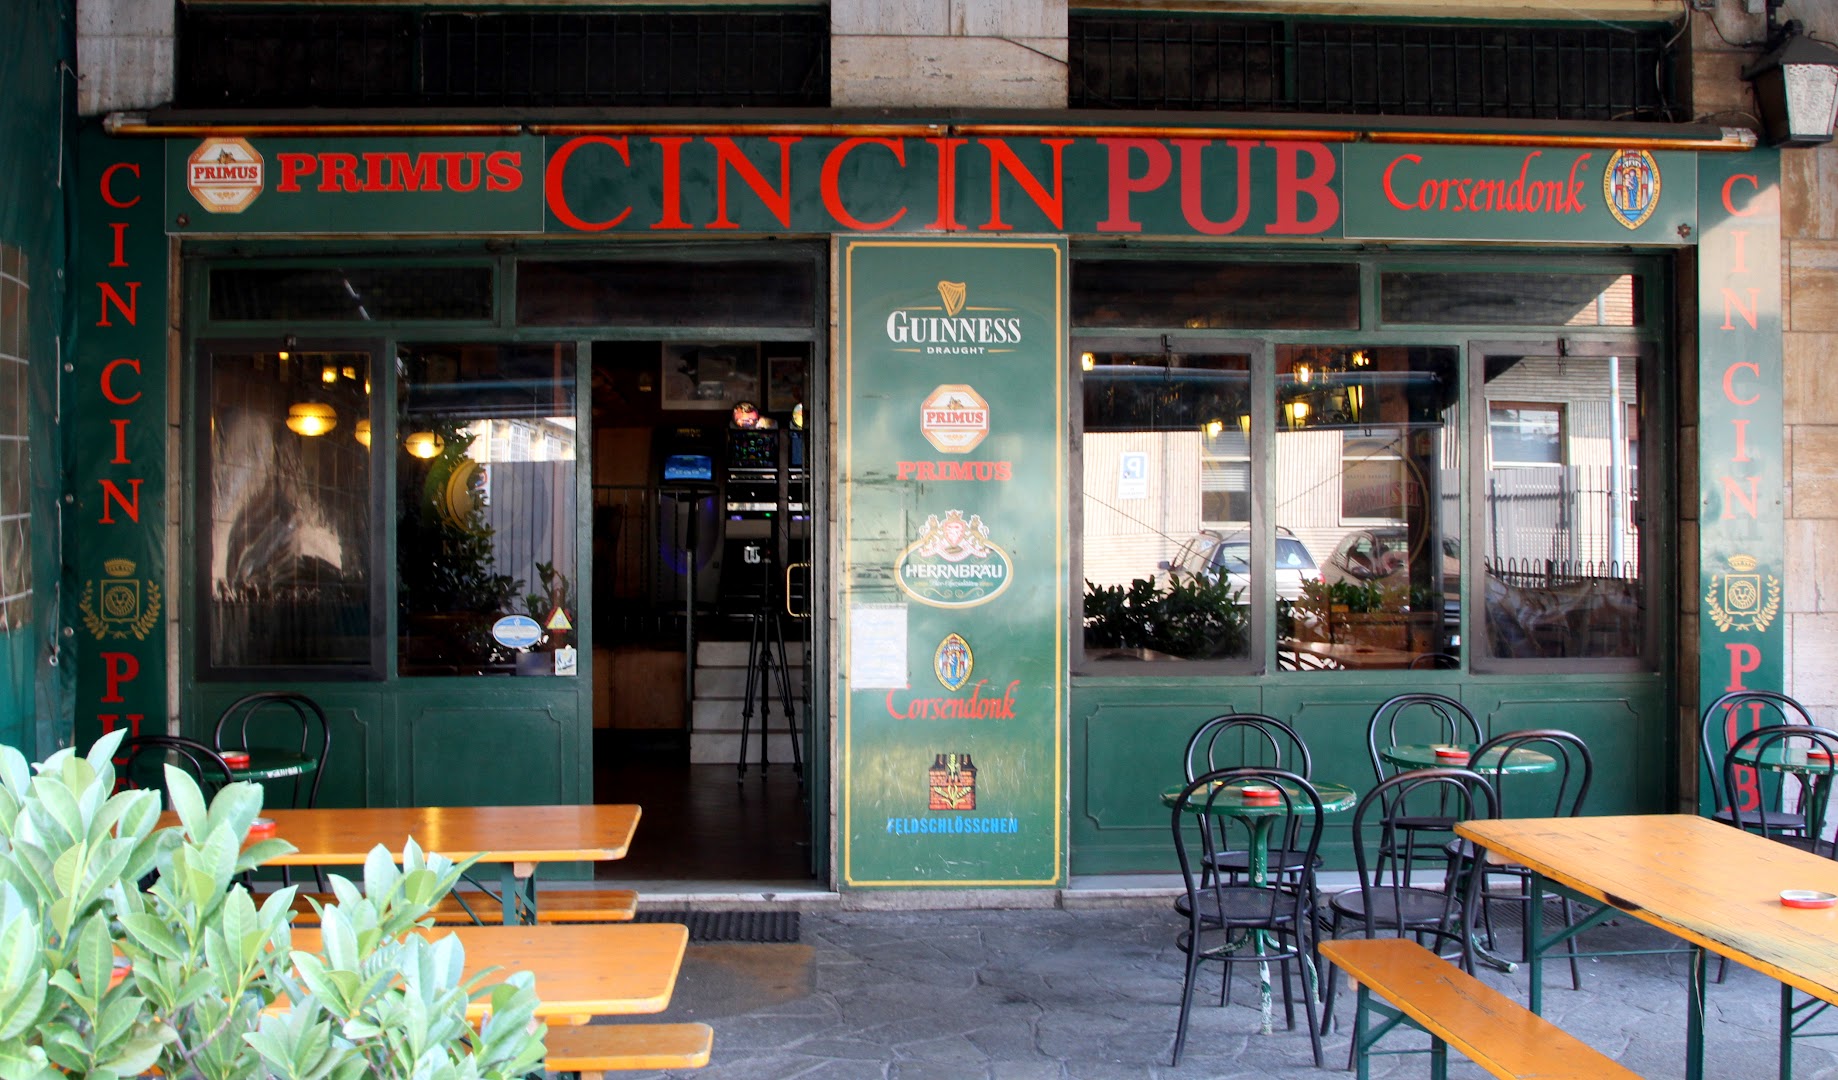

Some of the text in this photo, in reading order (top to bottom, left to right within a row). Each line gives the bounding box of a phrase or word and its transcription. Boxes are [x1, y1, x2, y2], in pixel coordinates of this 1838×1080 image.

[193, 166, 258, 180] PRIMUS
[277, 150, 523, 192] PRIMUS
[1097, 138, 1340, 235] PUB
[1382, 151, 1592, 214] Corsendonk
[886, 311, 1021, 344] GUINNESS
[926, 346, 985, 355] DRAUGHT
[926, 411, 984, 424] PRIMUS
[896, 461, 1012, 481] PRIMUS
[905, 564, 1002, 579] HERRNBRÄU
[886, 679, 1021, 721] Corsendonk
[887, 815, 1019, 834] FELDSCHLÖSSCHEN
